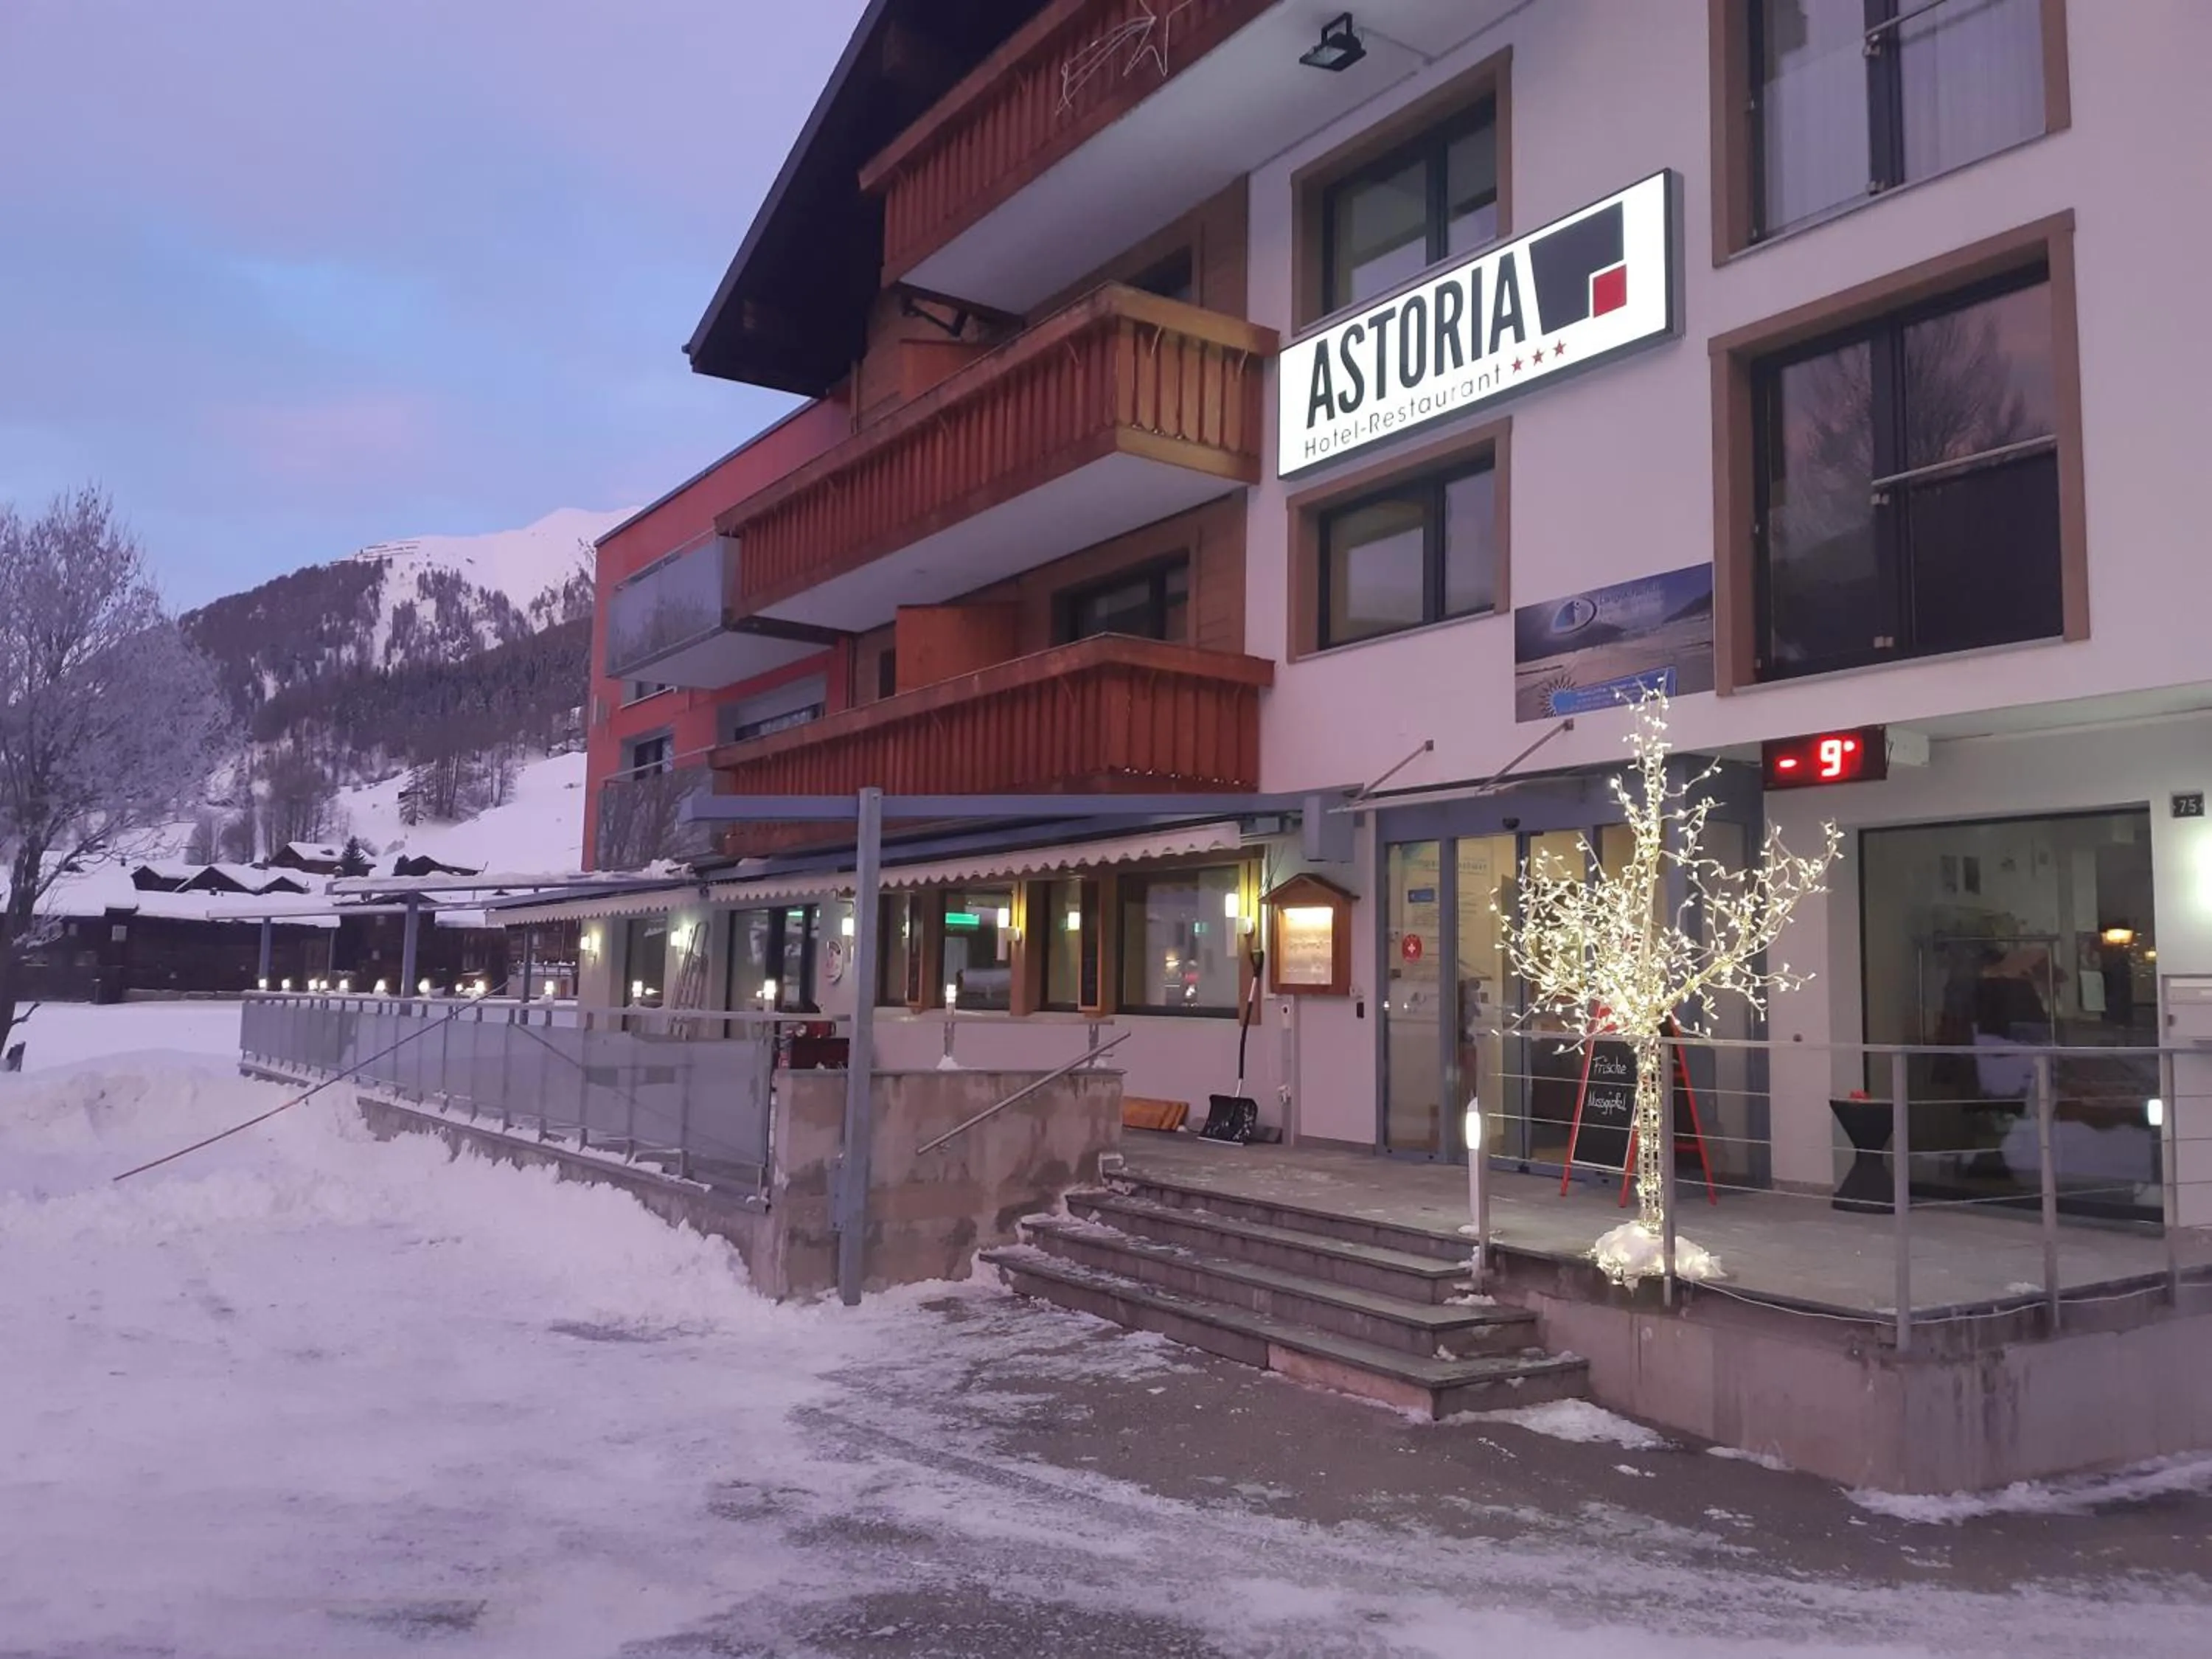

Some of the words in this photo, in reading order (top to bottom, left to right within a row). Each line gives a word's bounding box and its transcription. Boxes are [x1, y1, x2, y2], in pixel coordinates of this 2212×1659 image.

[1307, 251, 1526, 429] ASTORIA
[1304, 364, 1500, 459] Hotel-Restaurant
[2179, 799, 2197, 813] 75
[1593, 1055, 1627, 1074] Frische
